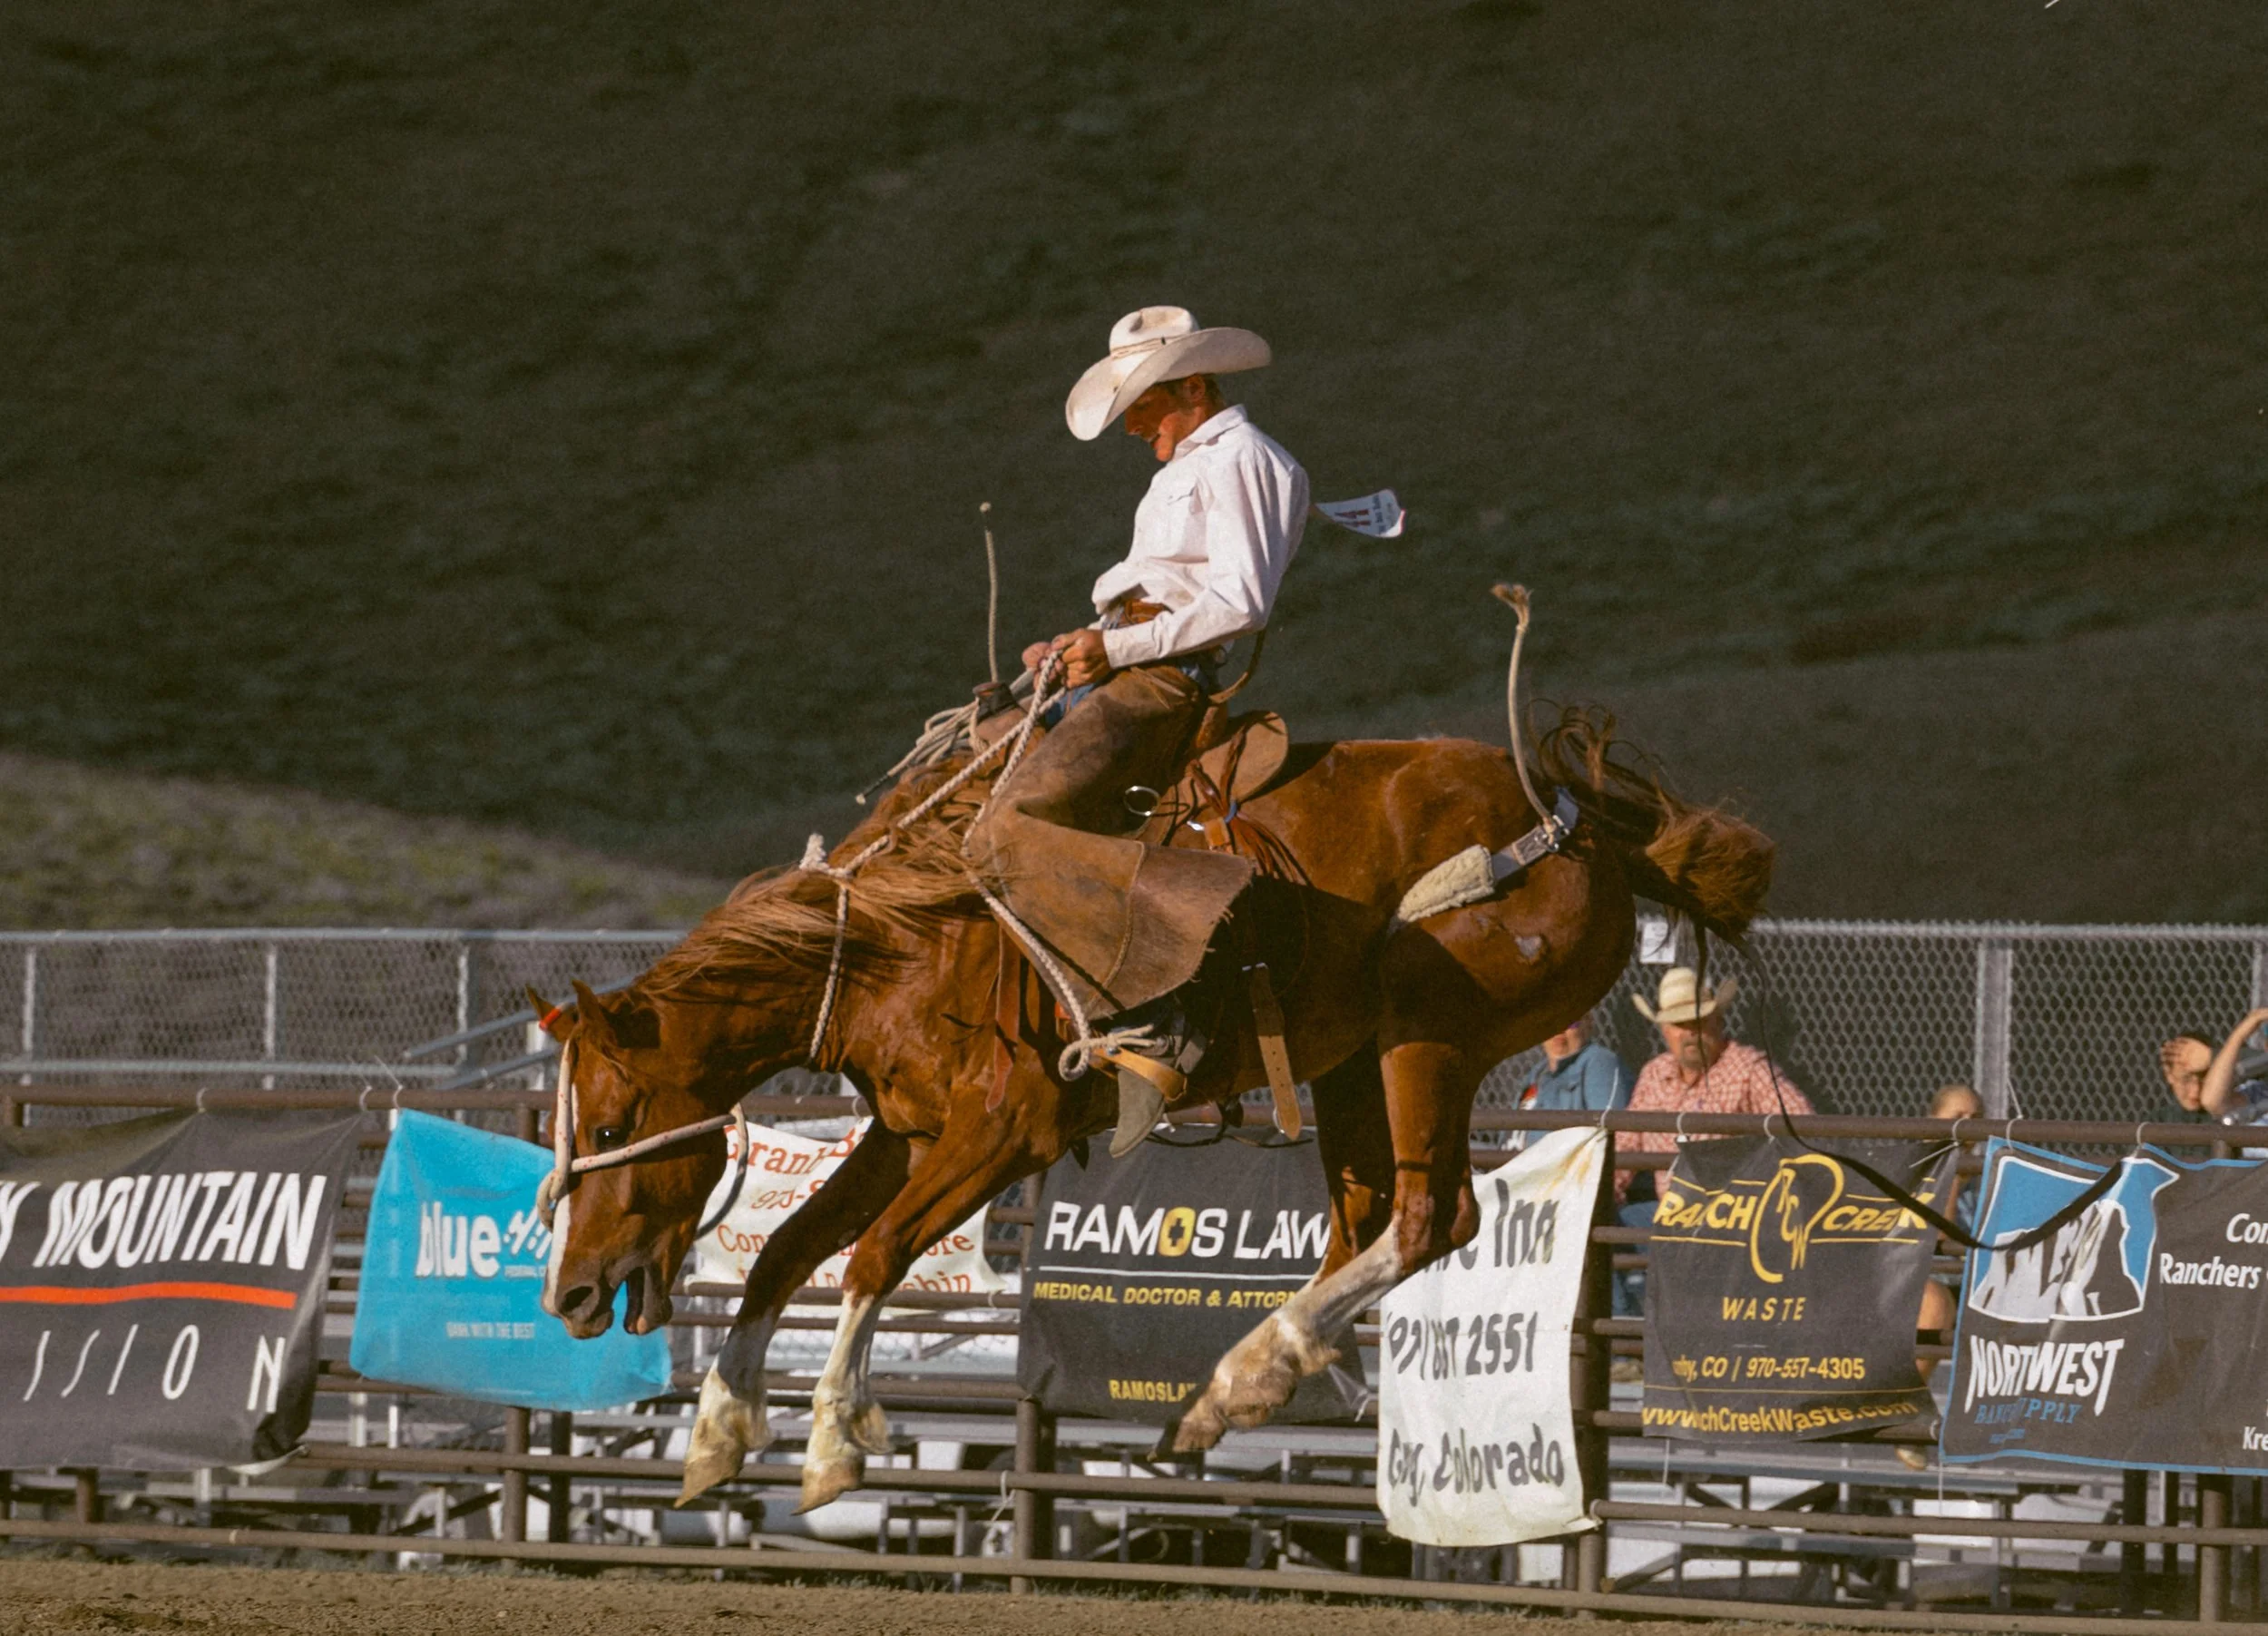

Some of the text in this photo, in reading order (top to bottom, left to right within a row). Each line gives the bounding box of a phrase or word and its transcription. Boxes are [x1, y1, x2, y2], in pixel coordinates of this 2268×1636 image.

[33, 1171, 327, 1270] MOUNTAIN
[415, 1200, 501, 1278] blue
[1044, 1200, 1331, 1259] RAMOS LAW
[1494, 1178, 1560, 1269] Inn
[1653, 1190, 1758, 1230] RACH
[1032, 1281, 1118, 1304] MEDICAL
[1123, 1288, 1203, 1307] DOCTOR
[1206, 1289, 1221, 1308] &
[2159, 1253, 2263, 1289] Ranchers
[1722, 1297, 1807, 1321] WASTE
[1465, 1311, 1538, 1376] 2551
[1701, 1357, 1728, 1379] CO
[1745, 1357, 1865, 1380] 970-557-4305
[1964, 1335, 2126, 1416] NORTWEST
